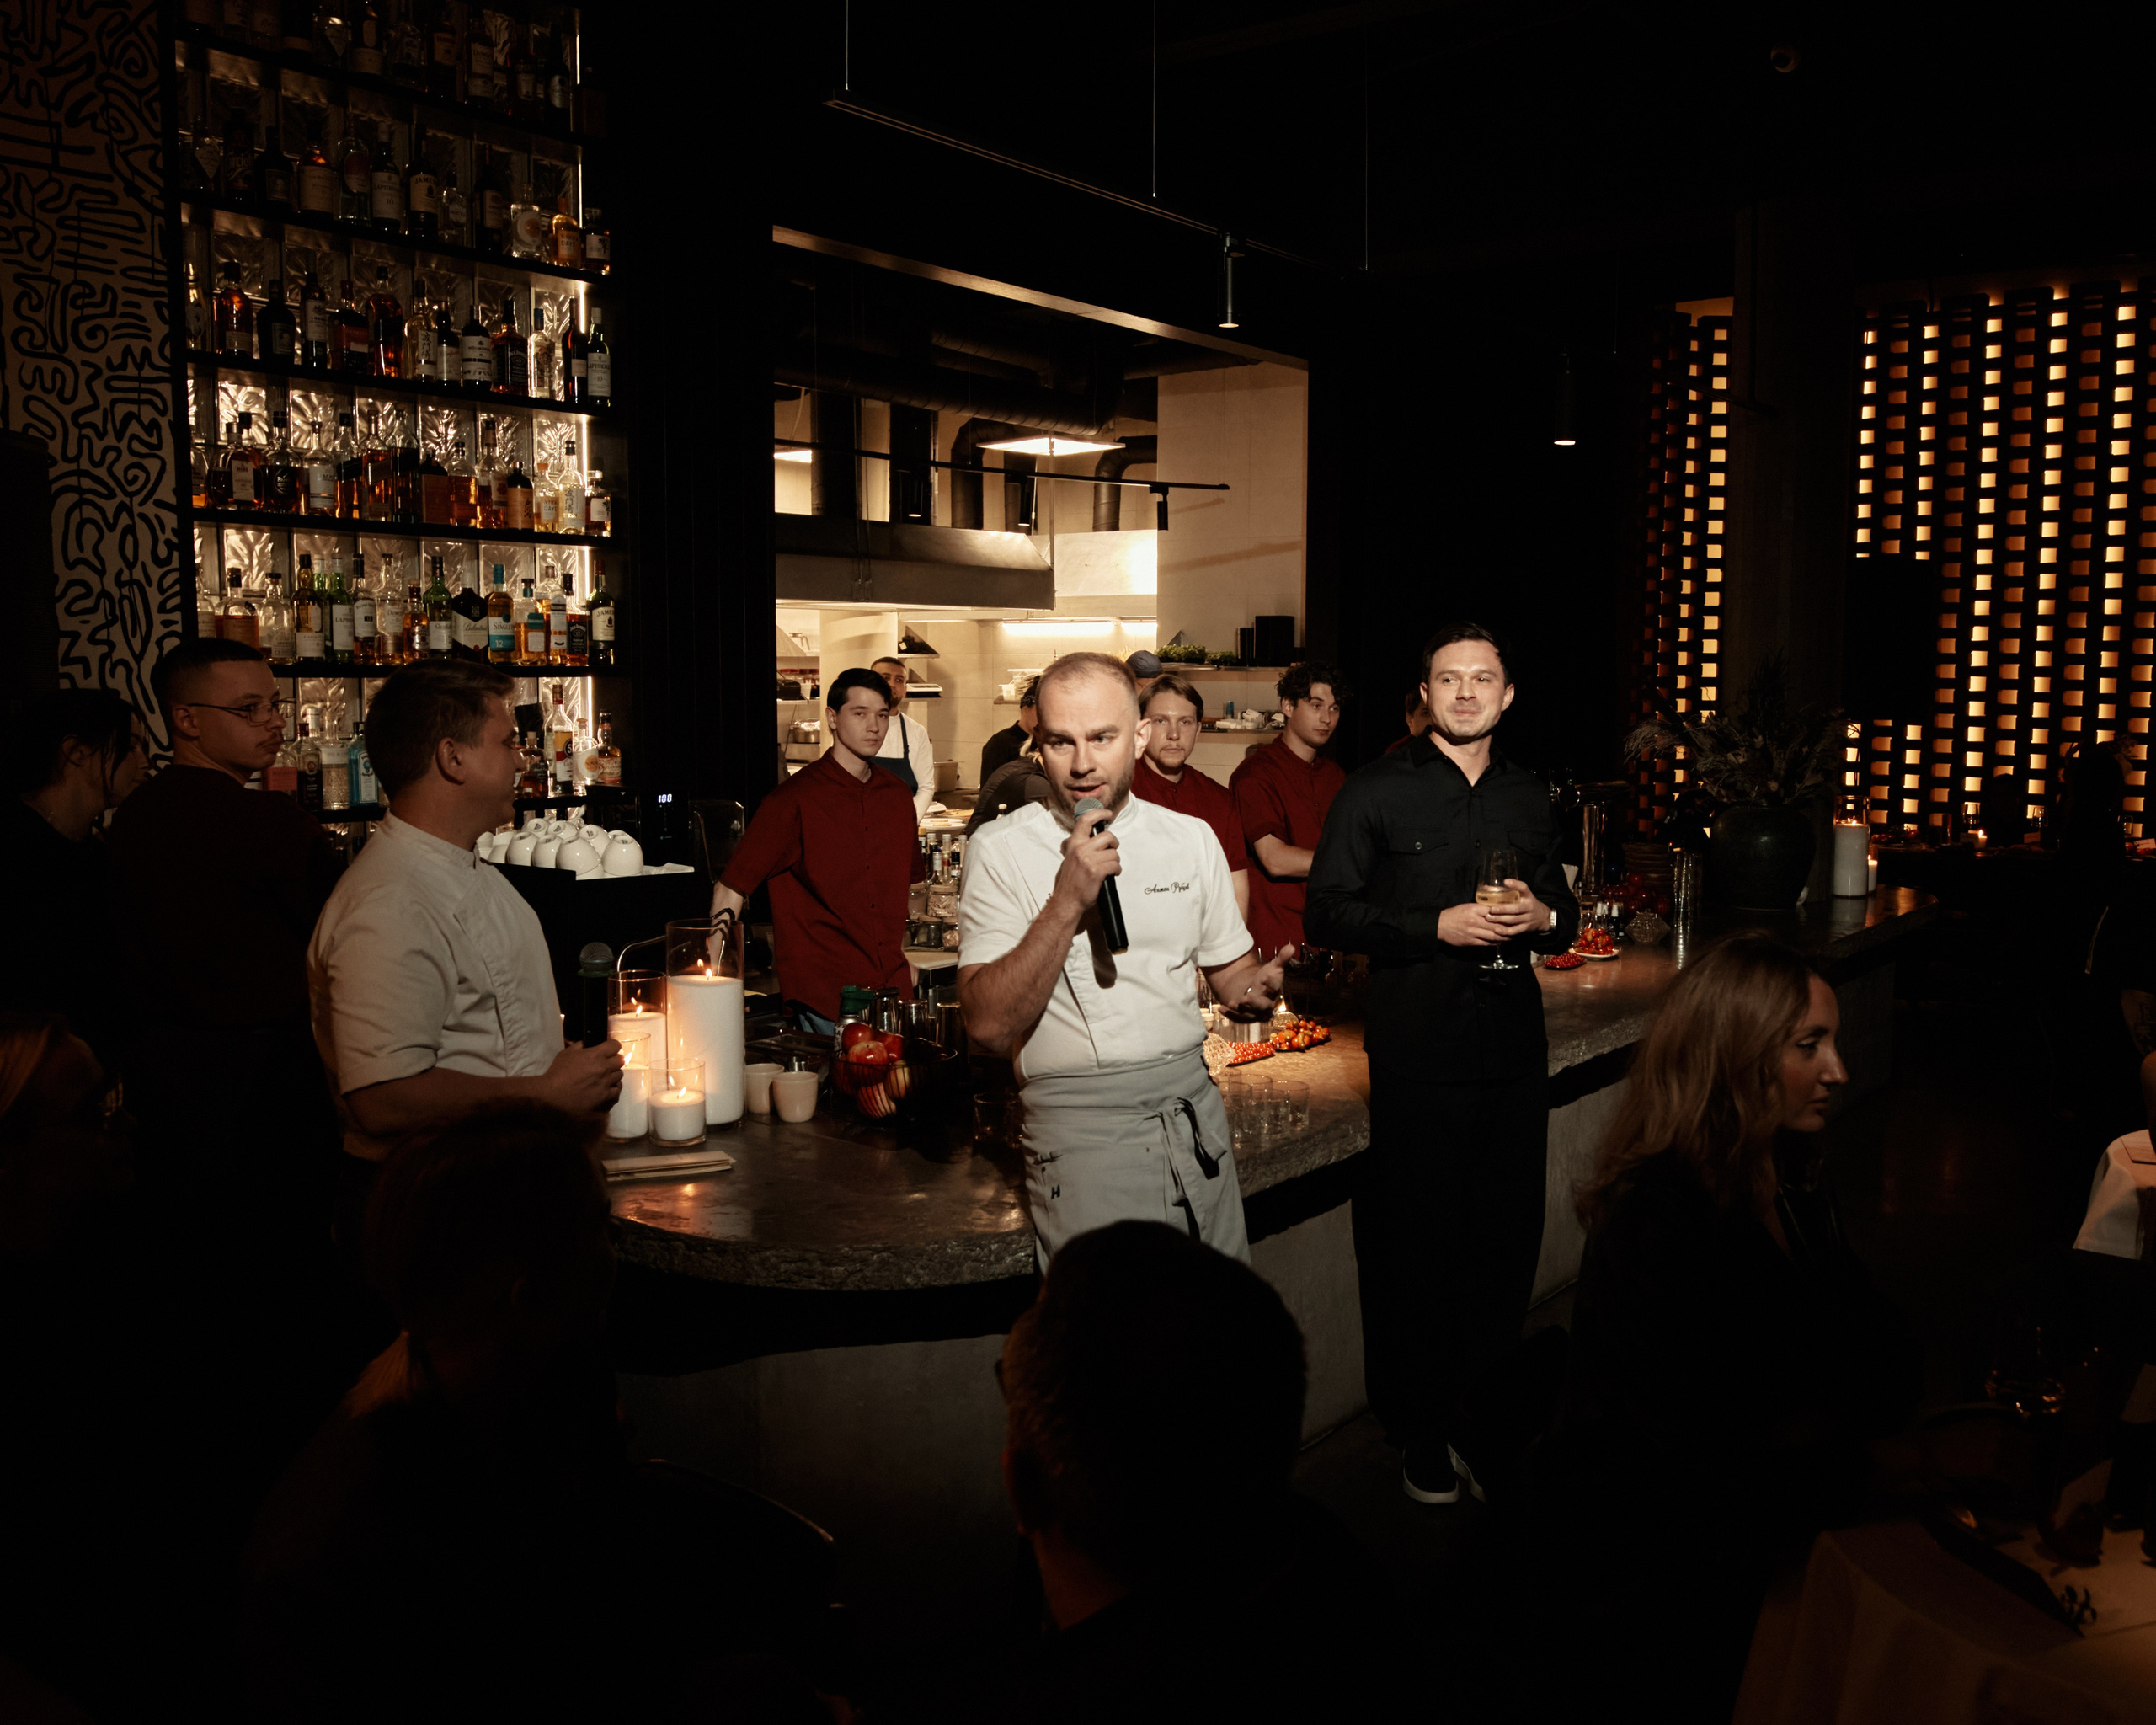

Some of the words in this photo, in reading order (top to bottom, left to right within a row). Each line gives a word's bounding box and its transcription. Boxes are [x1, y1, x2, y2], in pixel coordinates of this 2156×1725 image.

[596, 609, 615, 617] JAMES
[495, 639, 504, 648] 12
[658, 793, 672, 803] 100
